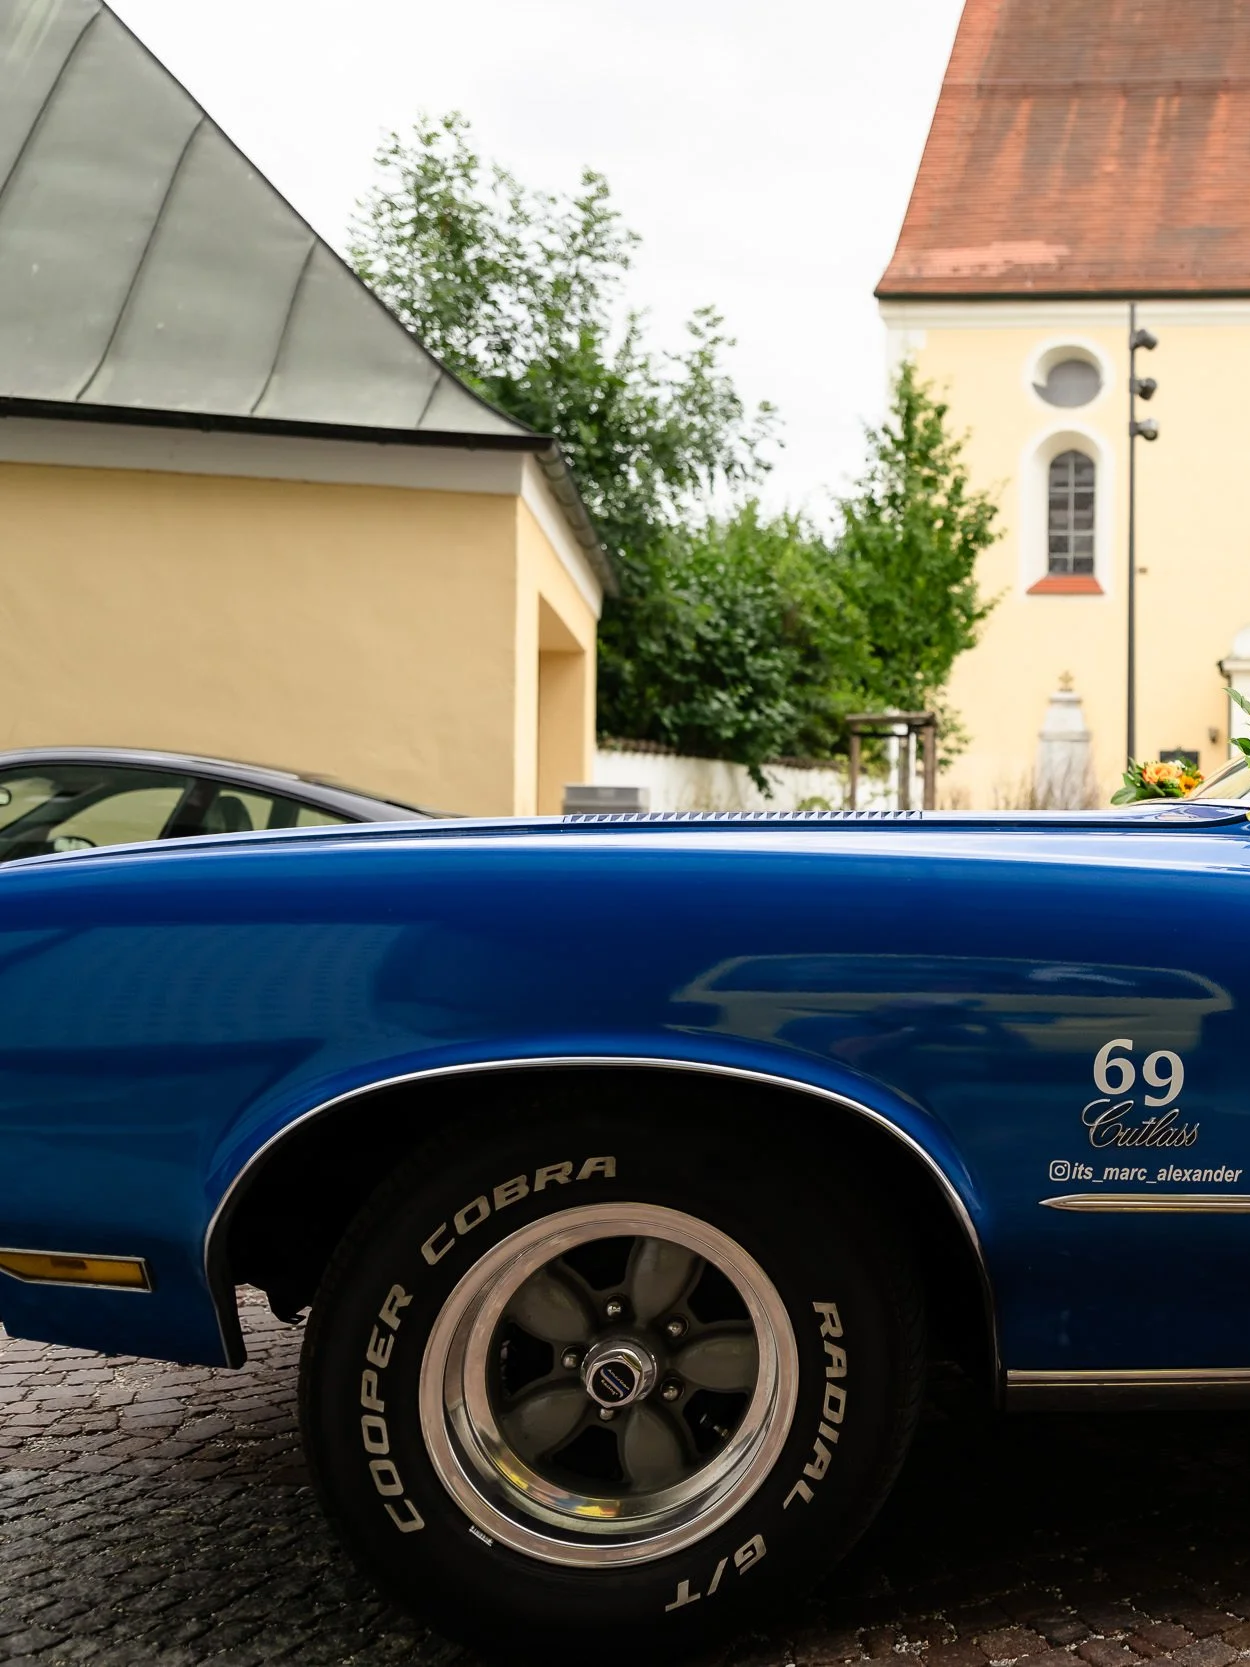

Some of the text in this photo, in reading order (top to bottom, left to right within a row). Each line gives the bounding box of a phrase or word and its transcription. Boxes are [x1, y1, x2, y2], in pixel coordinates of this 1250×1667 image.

[1093, 1038, 1185, 1107] 69
[1081, 1098, 1200, 1148] Cutlass
[1071, 1162, 1243, 1184] its_marc_alexander
[360, 1156, 617, 1533] COOPER COBRA
[665, 1301, 848, 1613] RADIAL G/T
